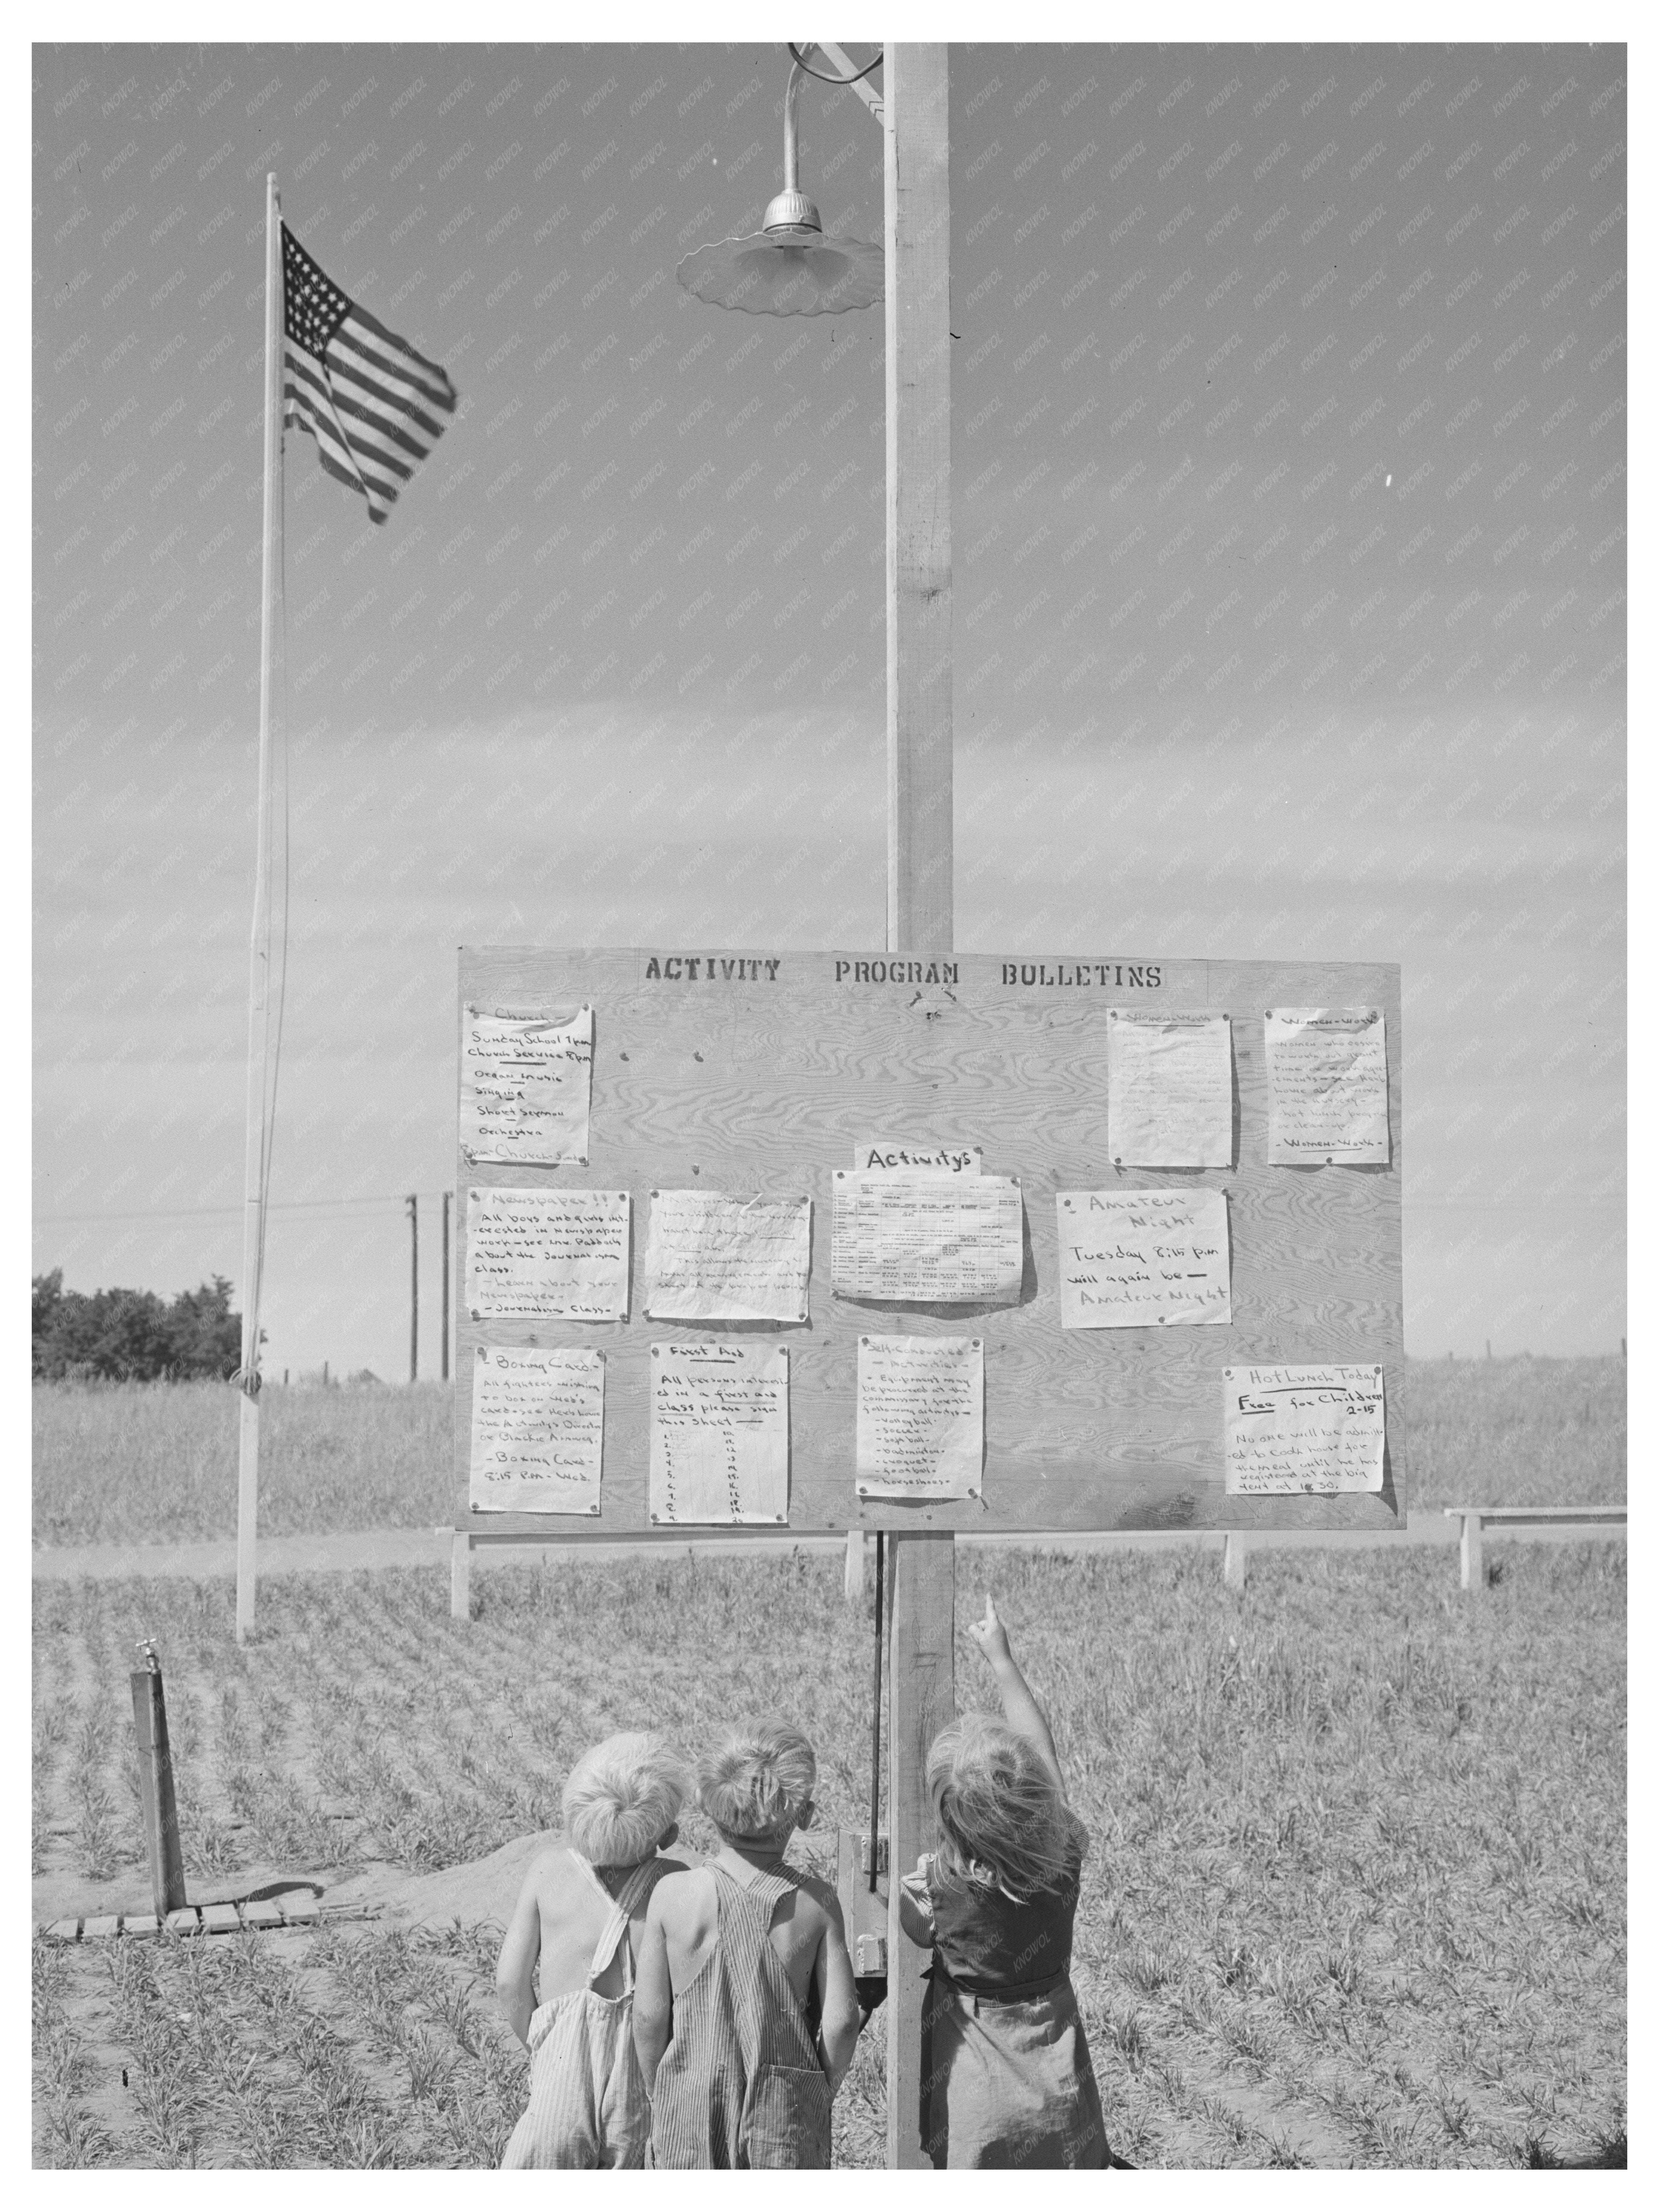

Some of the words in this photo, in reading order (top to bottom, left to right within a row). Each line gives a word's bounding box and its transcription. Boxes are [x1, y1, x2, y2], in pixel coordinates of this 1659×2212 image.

[645, 957, 780, 981] ACTIVITY
[835, 961, 959, 983] PROGRAM
[1002, 964, 1161, 987] BULLETINS
[472, 1031, 524, 1046] Sunday
[524, 1032, 561, 1044] School
[468, 1048, 510, 1057] Church
[514, 1049, 563, 1058] Service
[477, 1106, 516, 1115] Short
[867, 1149, 971, 1172] Activitys
[492, 1194, 587, 1207] Newspaper
[1090, 1195, 1187, 1211] Amateur
[507, 1213, 540, 1222] boys
[1128, 1214, 1195, 1229] Night
[536, 1225, 548, 1233] in
[1069, 1245, 1148, 1264] Tuesday
[1153, 1246, 1185, 1258] 8:15
[539, 1277, 580, 1287] about
[1067, 1274, 1098, 1284] will
[1107, 1271, 1150, 1284] again
[1161, 1270, 1183, 1279] be
[1080, 1290, 1163, 1305] Amateur
[1169, 1286, 1228, 1305] Night
[670, 1346, 708, 1356] First
[719, 1346, 744, 1358] Aid
[496, 1355, 548, 1374] Boxing
[504, 1380, 552, 1389] fighters
[661, 1375, 682, 1385] All
[687, 1376, 736, 1387] persons
[880, 1374, 939, 1384] Equipment
[1250, 1369, 1282, 1384] Hot
[1285, 1369, 1334, 1383] Lunch
[1334, 1368, 1379, 1389] Today
[715, 1389, 749, 1401] first
[1238, 1395, 1275, 1410] Free
[1290, 1397, 1315, 1409] for
[1318, 1390, 1382, 1404] Children
[657, 1402, 694, 1412] class
[701, 1405, 741, 1414] please
[1346, 1405, 1376, 1415] 2-15
[1260, 1433, 1285, 1442] one
[1290, 1428, 1318, 1437] will
[1251, 1449, 1266, 1457] to
[1307, 1443, 1339, 1453] house
[1345, 1443, 1368, 1452] for
[496, 1451, 551, 1466] Boxing
[883, 1457, 927, 1466] croquet
[1300, 1458, 1329, 1468] until
[1360, 1456, 1379, 1465] has
[1346, 1468, 1368, 1479] big
[1239, 1482, 1268, 1491] tent
[1276, 1481, 1291, 1490] at
